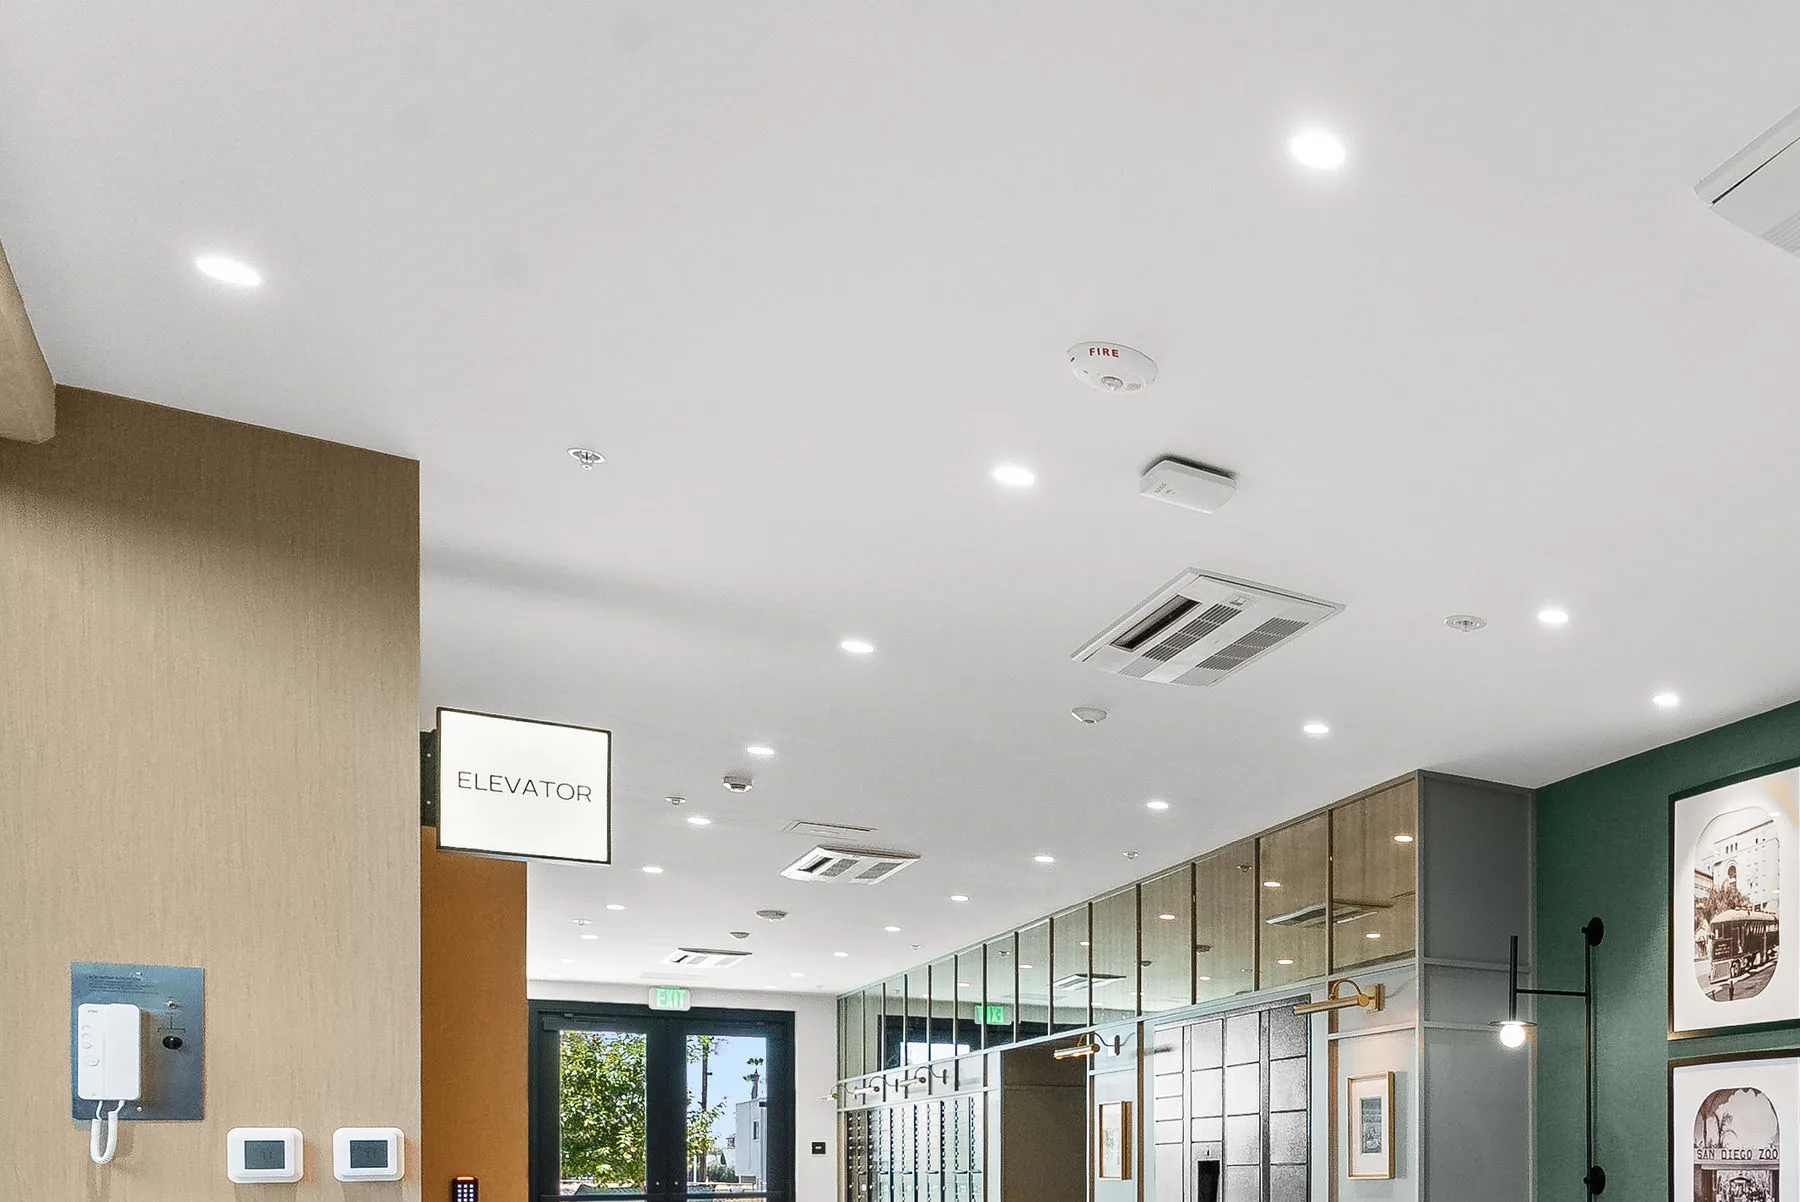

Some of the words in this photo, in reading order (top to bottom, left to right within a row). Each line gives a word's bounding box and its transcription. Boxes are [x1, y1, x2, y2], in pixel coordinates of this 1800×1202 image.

[1089, 347, 1119, 358] FIRE
[457, 770, 592, 803] ELEVATOR
[655, 988, 686, 1009] EXIT
[1696, 1149, 1715, 1160] SAN
[1721, 1149, 1752, 1160] DIEGO
[1758, 1148, 1779, 1160] ZOO
